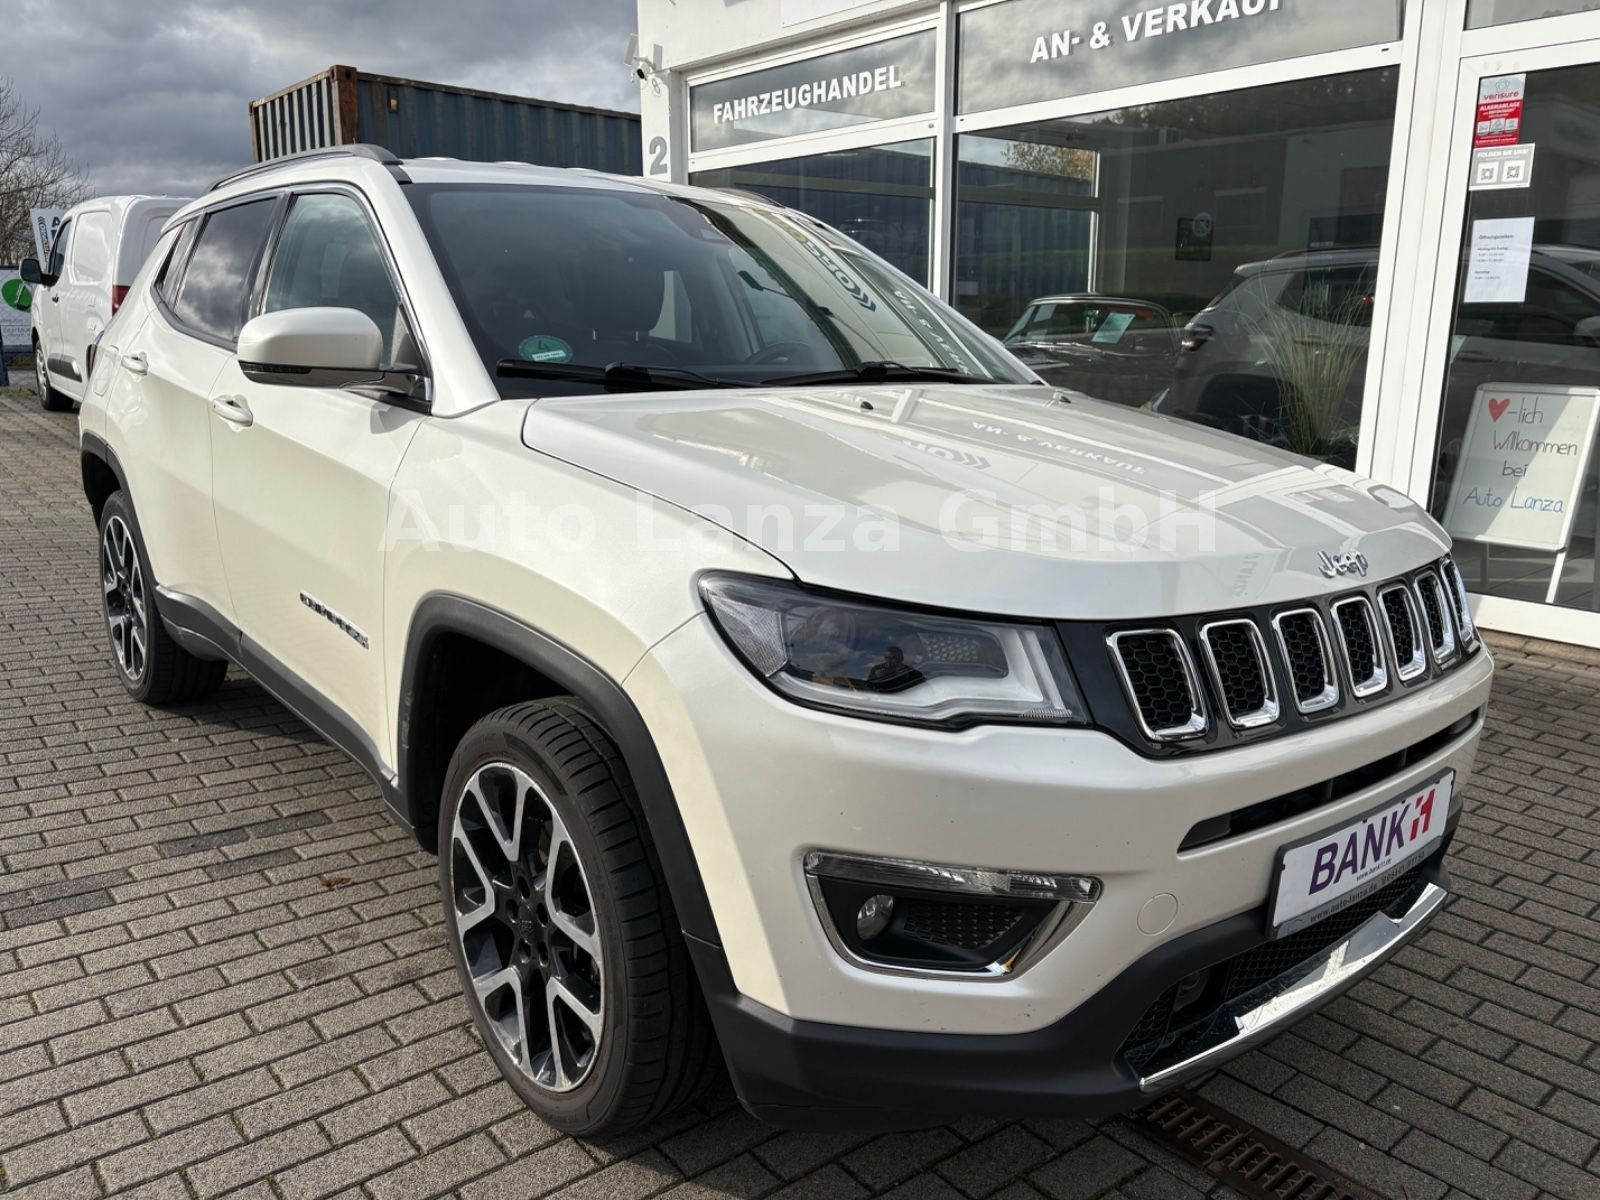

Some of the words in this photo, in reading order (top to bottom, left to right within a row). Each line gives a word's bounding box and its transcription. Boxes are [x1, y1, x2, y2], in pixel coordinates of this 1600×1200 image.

[1030, 29, 1080, 63] AN-
[1089, 21, 1110, 50] &
[713, 64, 902, 124] FAHRZEUGHANDEL
[1484, 91, 1519, 100] verisure
[649, 136, 668, 176] 2
[1502, 460, 1528, 478] bei
[1463, 487, 1503, 508] Auto
[1510, 486, 1564, 513] Lanza
[1317, 550, 1369, 579] Jeep
